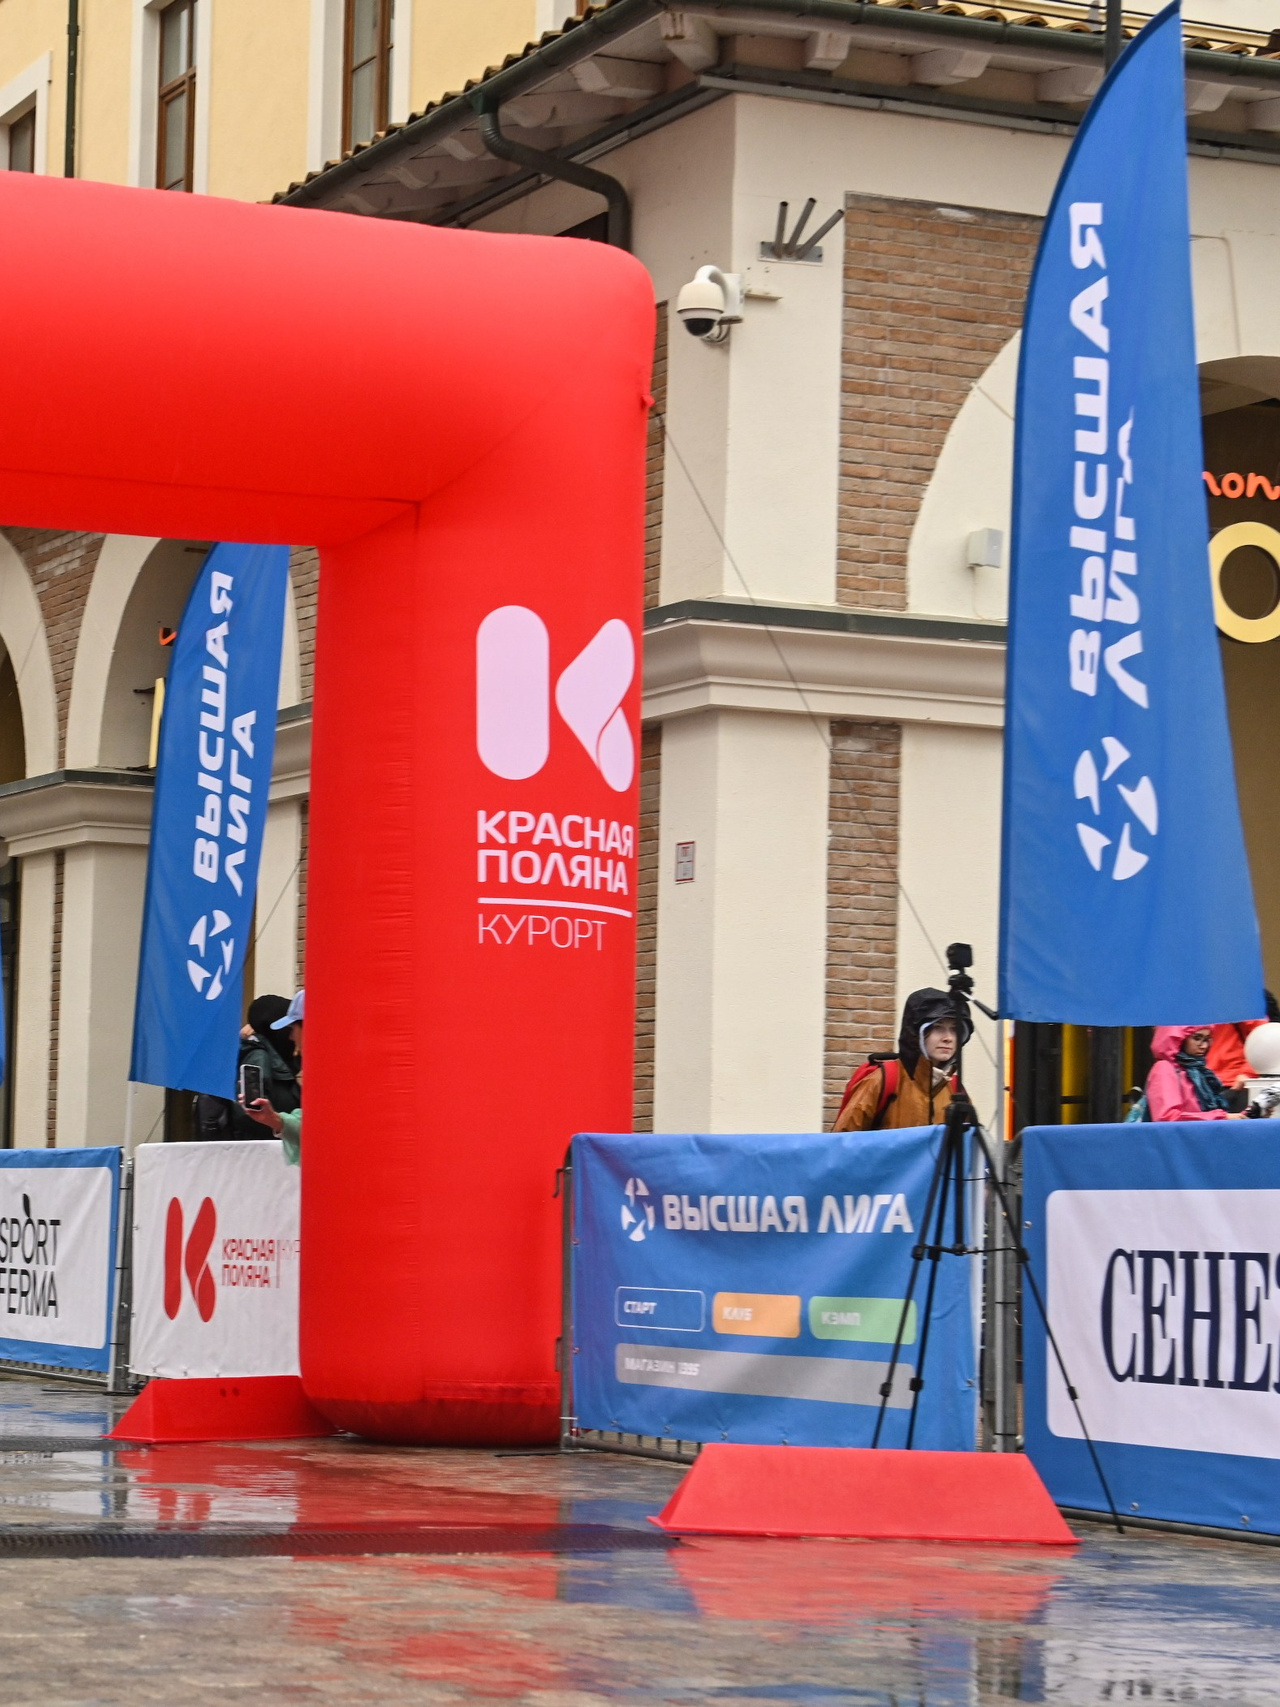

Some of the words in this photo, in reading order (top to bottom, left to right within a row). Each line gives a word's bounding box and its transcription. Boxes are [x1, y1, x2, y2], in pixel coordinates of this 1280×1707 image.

[1069, 202, 1109, 697] ВЫСШАЯ
[1104, 404, 1149, 709] ЛИГА
[193, 570, 234, 884] ВЫСШАЯ
[225, 709, 257, 898] ЛИГА
[477, 809, 634, 859] КРАСНАЯ
[477, 848, 629, 896] ПОЛЯНА
[477, 913, 608, 952] КУРОРТ
[661, 1193, 810, 1234] ВЫСШАЯ
[817, 1193, 916, 1234] ЛИГА
[222, 1238, 276, 1262] КРАСНАЯ
[221, 1264, 271, 1288] ПОЛЯНА
[623, 1300, 658, 1316] СТАРТ
[722, 1306, 754, 1322] КЛУБ
[1101, 1248, 1280, 1395] СЕНЕ
[624, 1357, 676, 1375] МАГАЗИН
